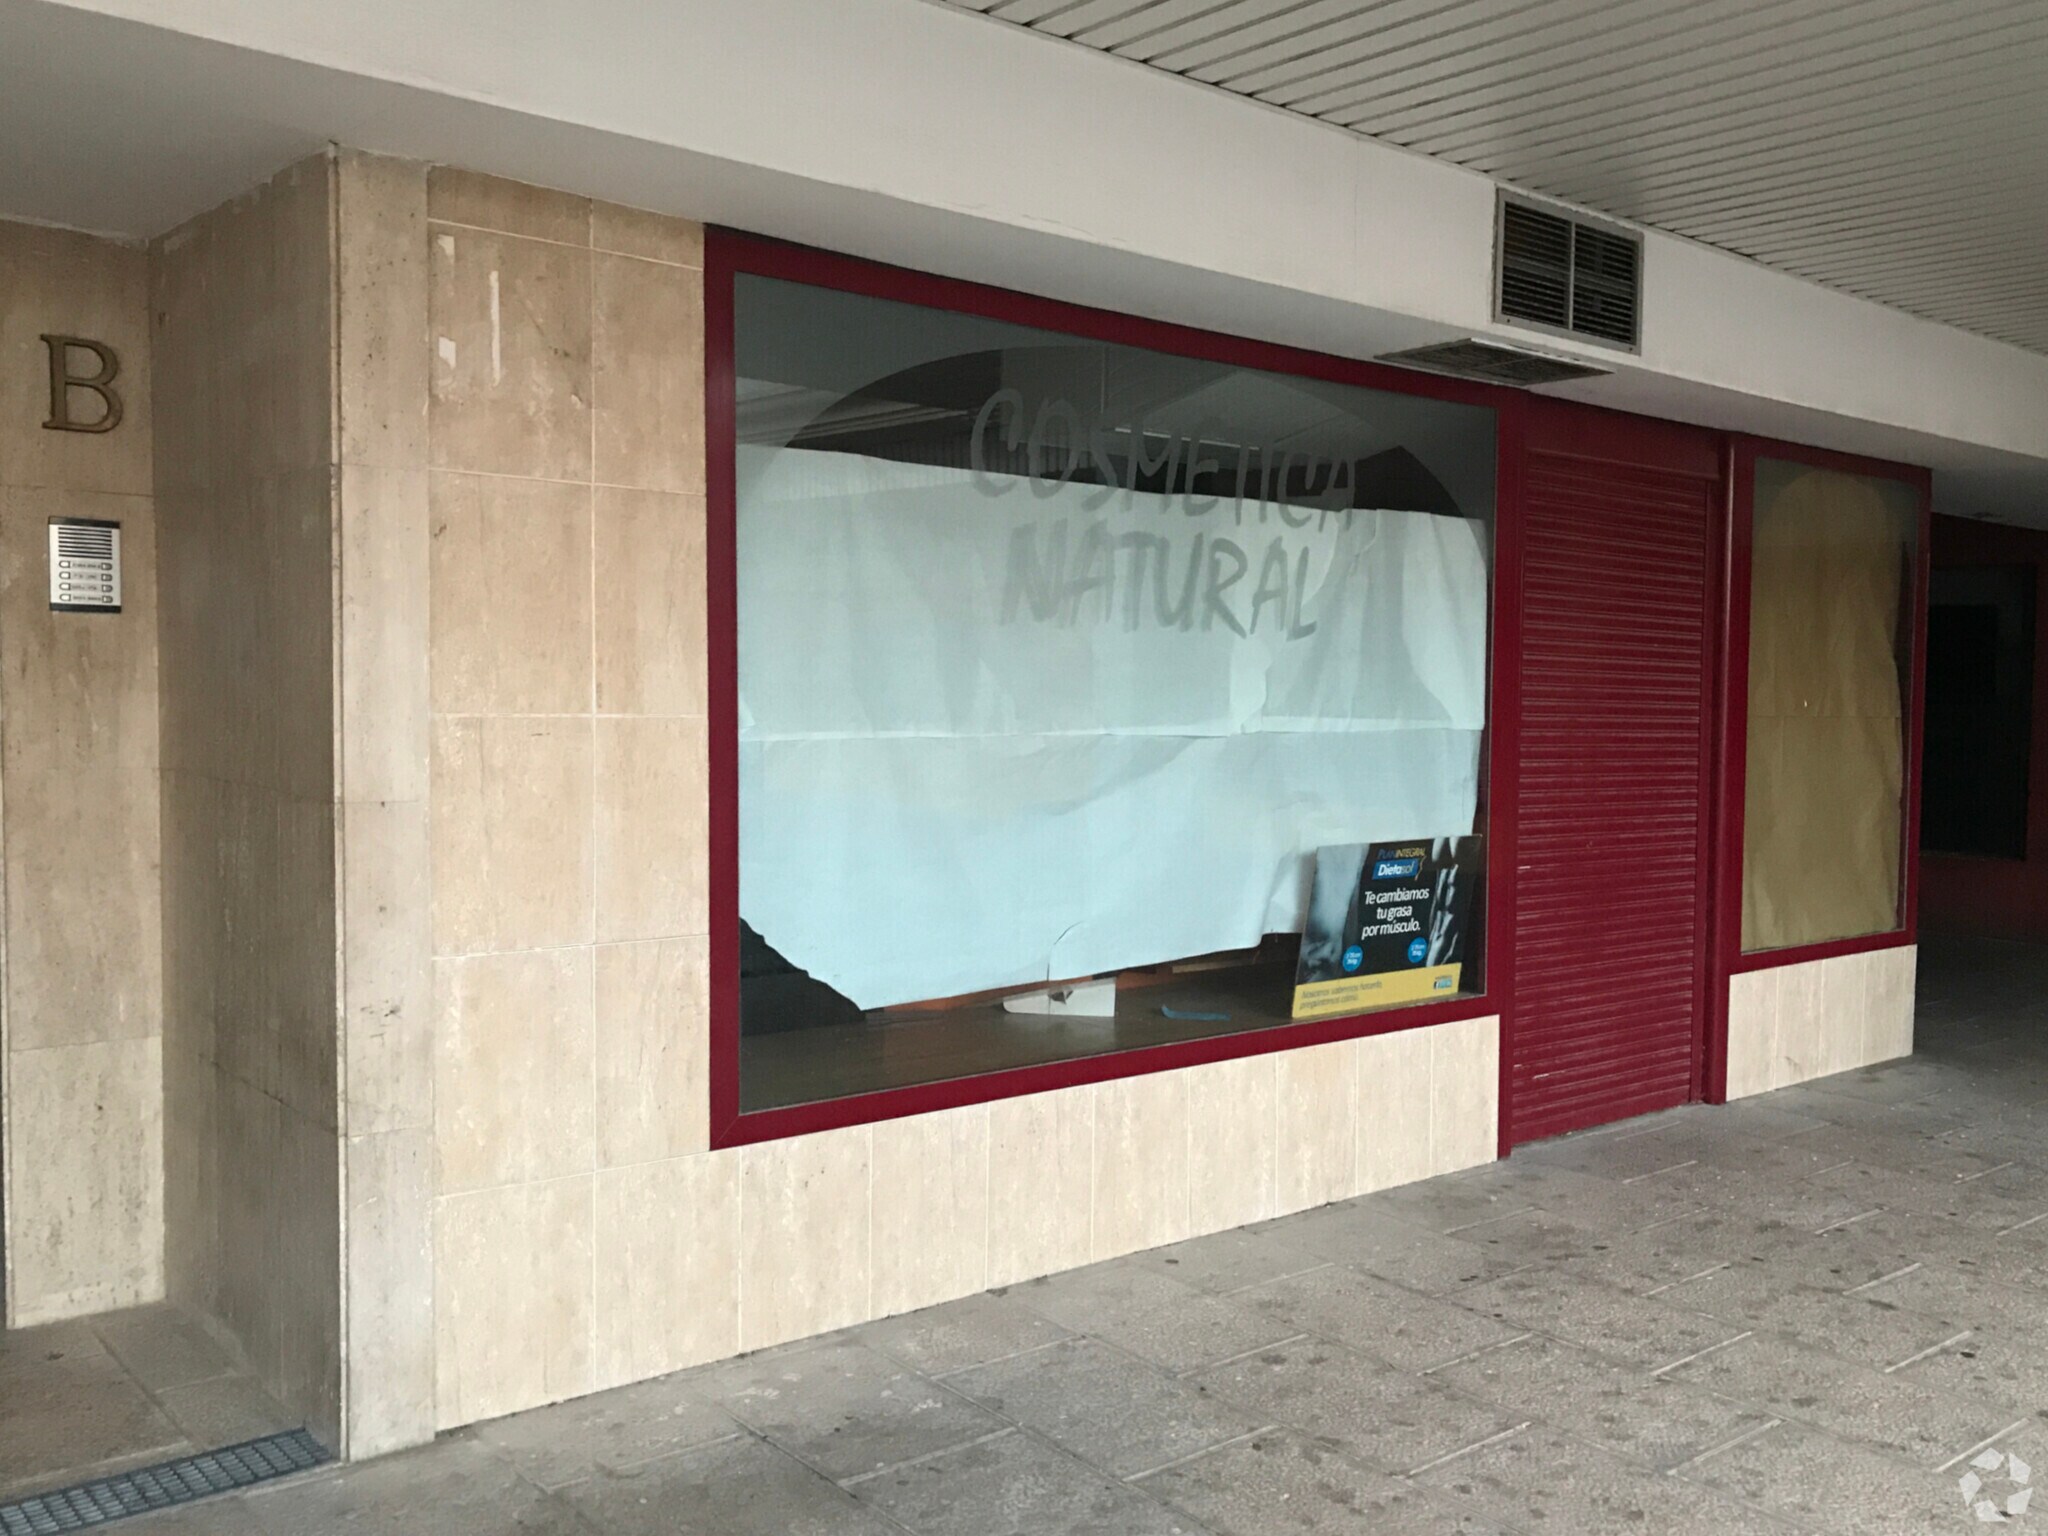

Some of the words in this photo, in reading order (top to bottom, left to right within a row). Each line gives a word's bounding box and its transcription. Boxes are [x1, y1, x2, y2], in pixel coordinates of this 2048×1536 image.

[40, 333, 123, 434] B
[970, 387, 1356, 533] COSMETICA
[1000, 518, 1318, 642] NATURAL
[1377, 860, 1416, 877] Dietasol
[1364, 891, 1376, 905] Te
[1376, 887, 1430, 904] cambiamos
[1376, 906, 1387, 920] tu
[1387, 905, 1413, 922] grasa
[1361, 924, 1380, 941] por
[1379, 917, 1421, 936] músculo.
